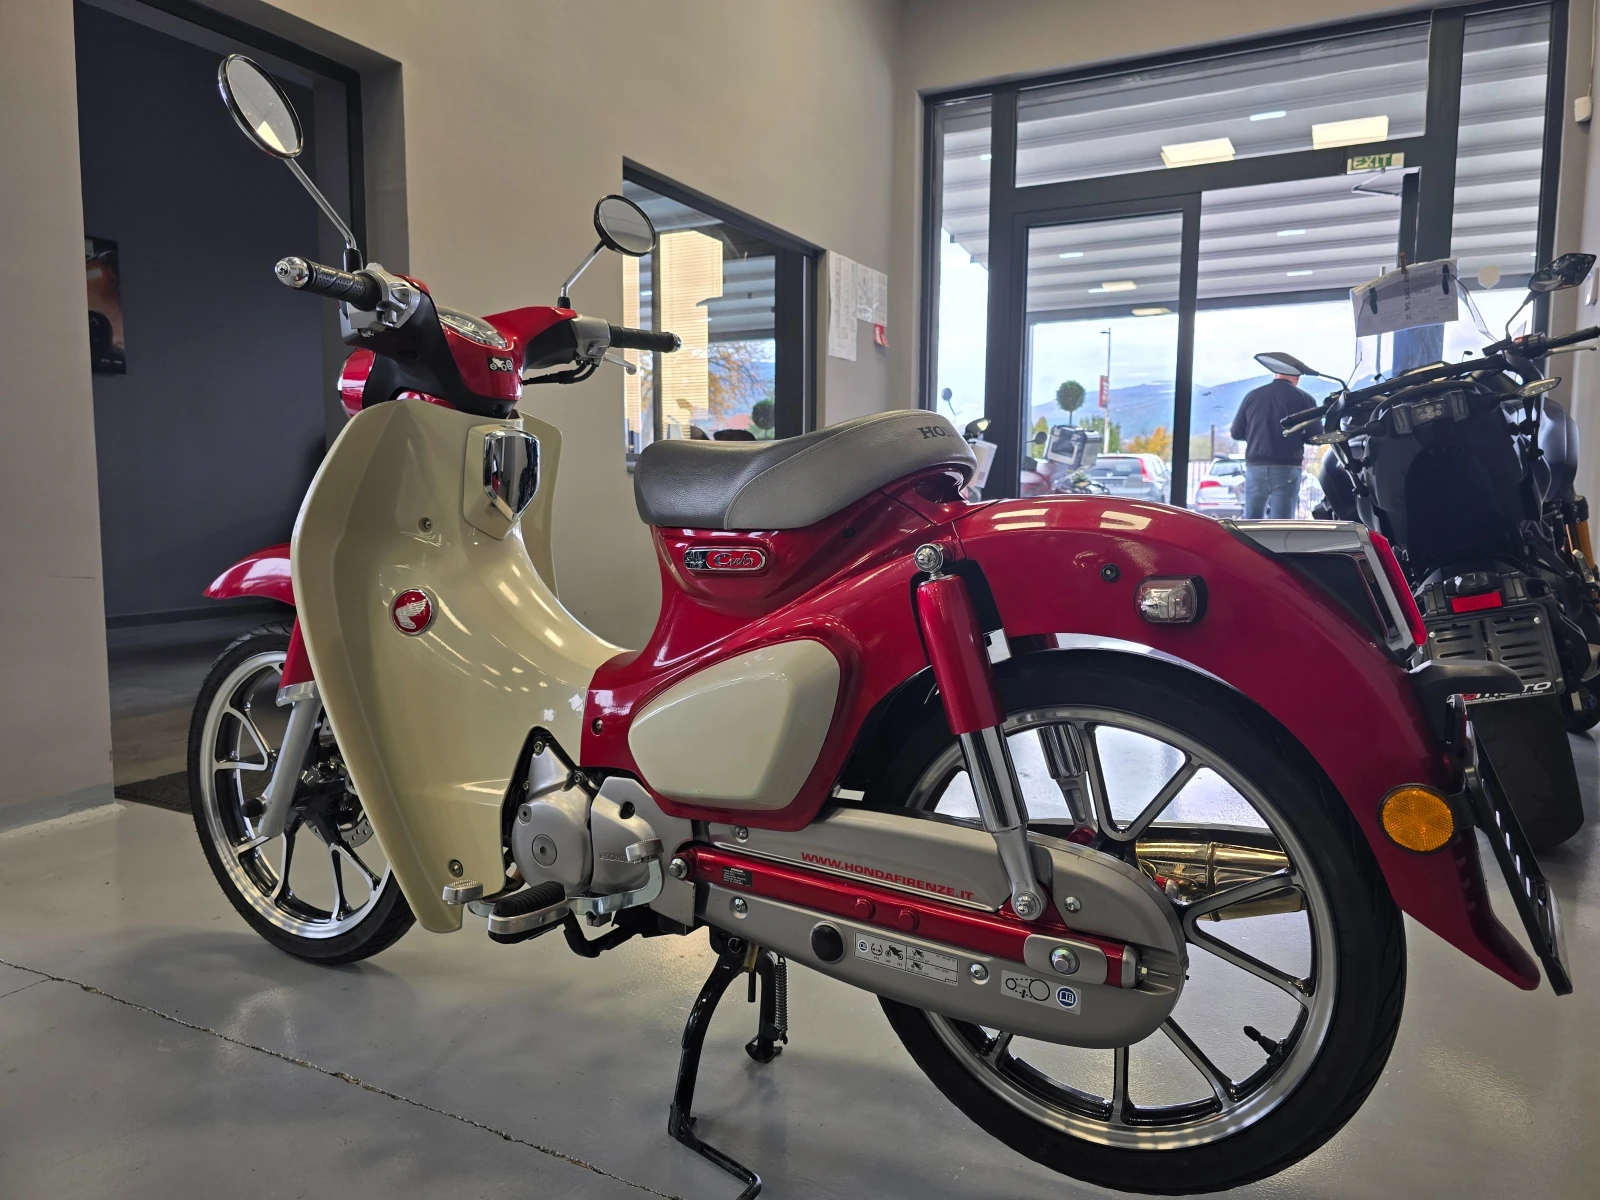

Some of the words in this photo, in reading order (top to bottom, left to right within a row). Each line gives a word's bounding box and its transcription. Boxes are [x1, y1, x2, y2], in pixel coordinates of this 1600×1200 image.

[1352, 153, 1391, 169] EXIT
[713, 552, 754, 567] Cub
[801, 852, 974, 901] WWW.HONDAFIRENZE.IT
